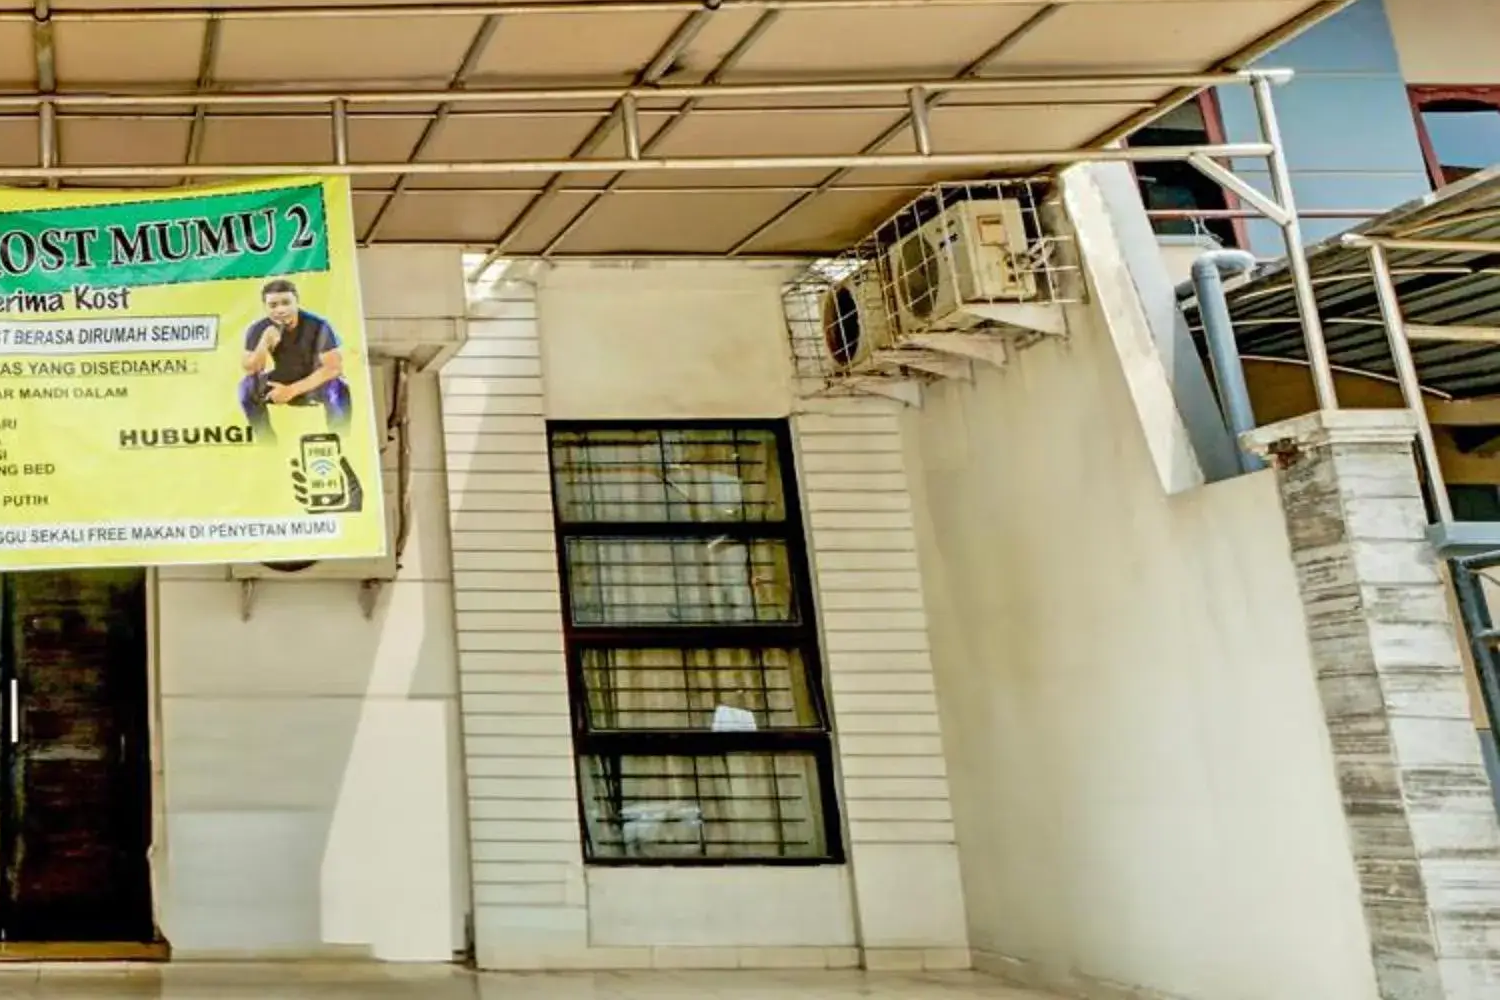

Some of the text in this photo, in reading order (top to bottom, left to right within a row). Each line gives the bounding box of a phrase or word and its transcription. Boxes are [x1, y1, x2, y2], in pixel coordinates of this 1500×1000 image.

[108, 208, 276, 266] MUMU
[286, 205, 315, 249] 2
[73, 284, 131, 310] Kost
[13, 328, 75, 345] BERASA
[78, 326, 147, 345] DIRUMAH
[151, 324, 210, 342] SENDIRI
[27, 360, 77, 376] YANG
[80, 358, 188, 376] DISEDIAKAN
[19, 387, 69, 399] MANDI
[73, 386, 129, 399] DALAM
[119, 425, 254, 447] HUBUNGI
[23, 462, 56, 475] BED
[2, 494, 49, 507] PUTIH
[31, 528, 85, 543] SEKALI
[88, 527, 127, 541] FREE
[132, 525, 186, 540] MAKAN
[189, 524, 205, 538] DI
[209, 521, 287, 538] PENYETAN
[291, 520, 337, 534] MUMU
